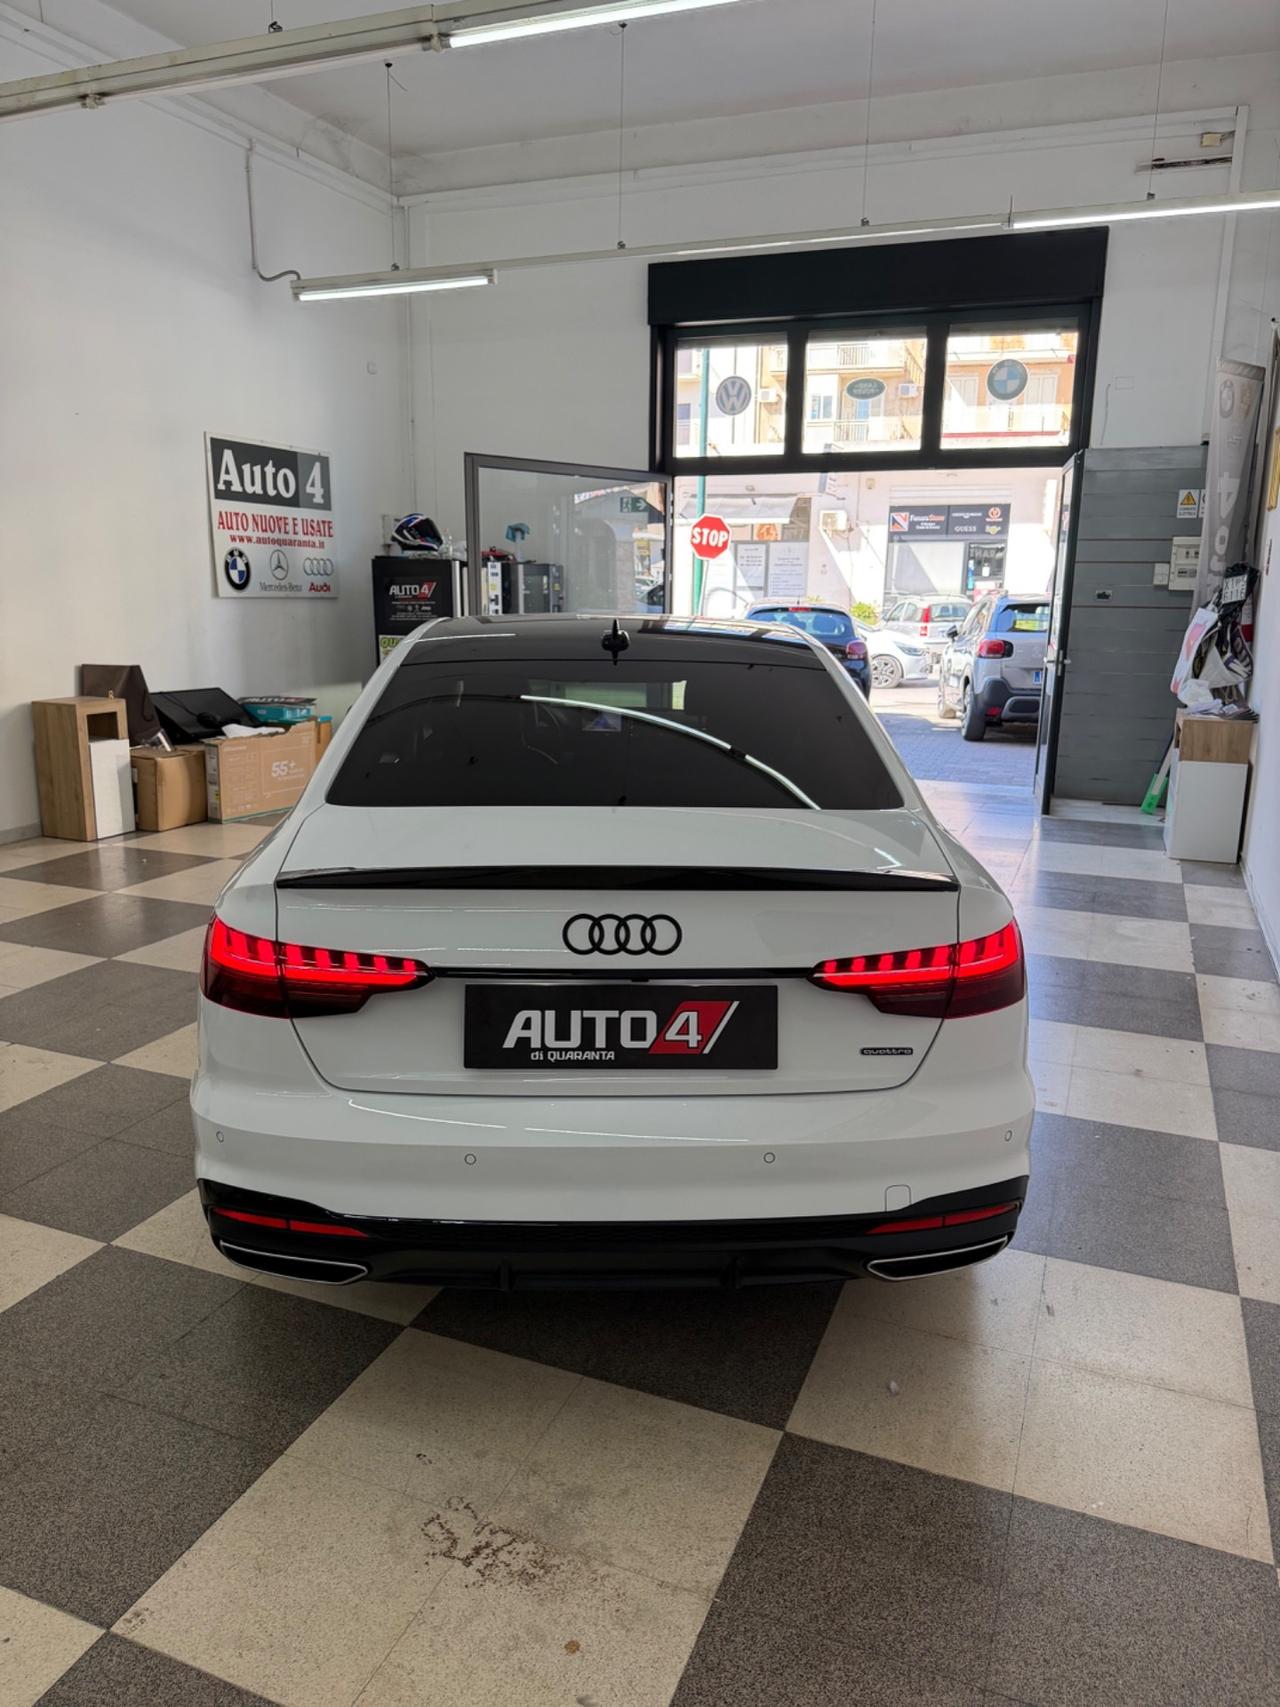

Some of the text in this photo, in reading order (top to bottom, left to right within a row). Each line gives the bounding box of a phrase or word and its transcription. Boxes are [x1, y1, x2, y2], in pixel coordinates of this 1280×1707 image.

[217, 449, 325, 504] Auto 4
[217, 511, 334, 538] AUTO NUOVE E USATE
[229, 534, 325, 549] www.autoquaranta.it
[692, 527, 728, 547] STOP
[308, 582, 331, 592] Audi
[531, 1050, 615, 1062] di QUARANTA
[863, 1048, 912, 1056] quattro
